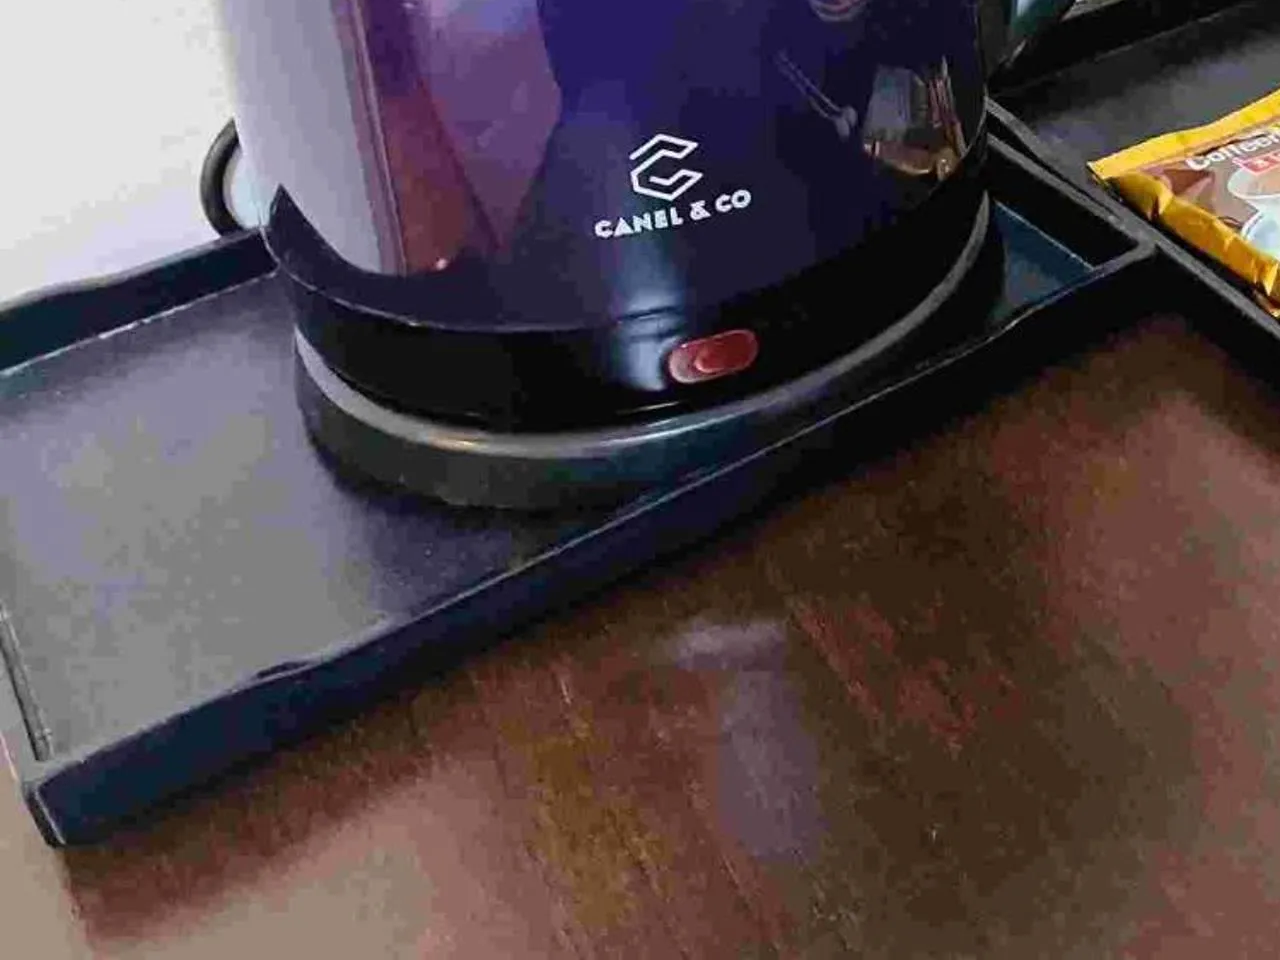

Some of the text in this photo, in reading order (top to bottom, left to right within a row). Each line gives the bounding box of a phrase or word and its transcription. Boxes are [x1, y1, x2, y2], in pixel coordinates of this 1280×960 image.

[594, 189, 752, 238] CANEL & CO
